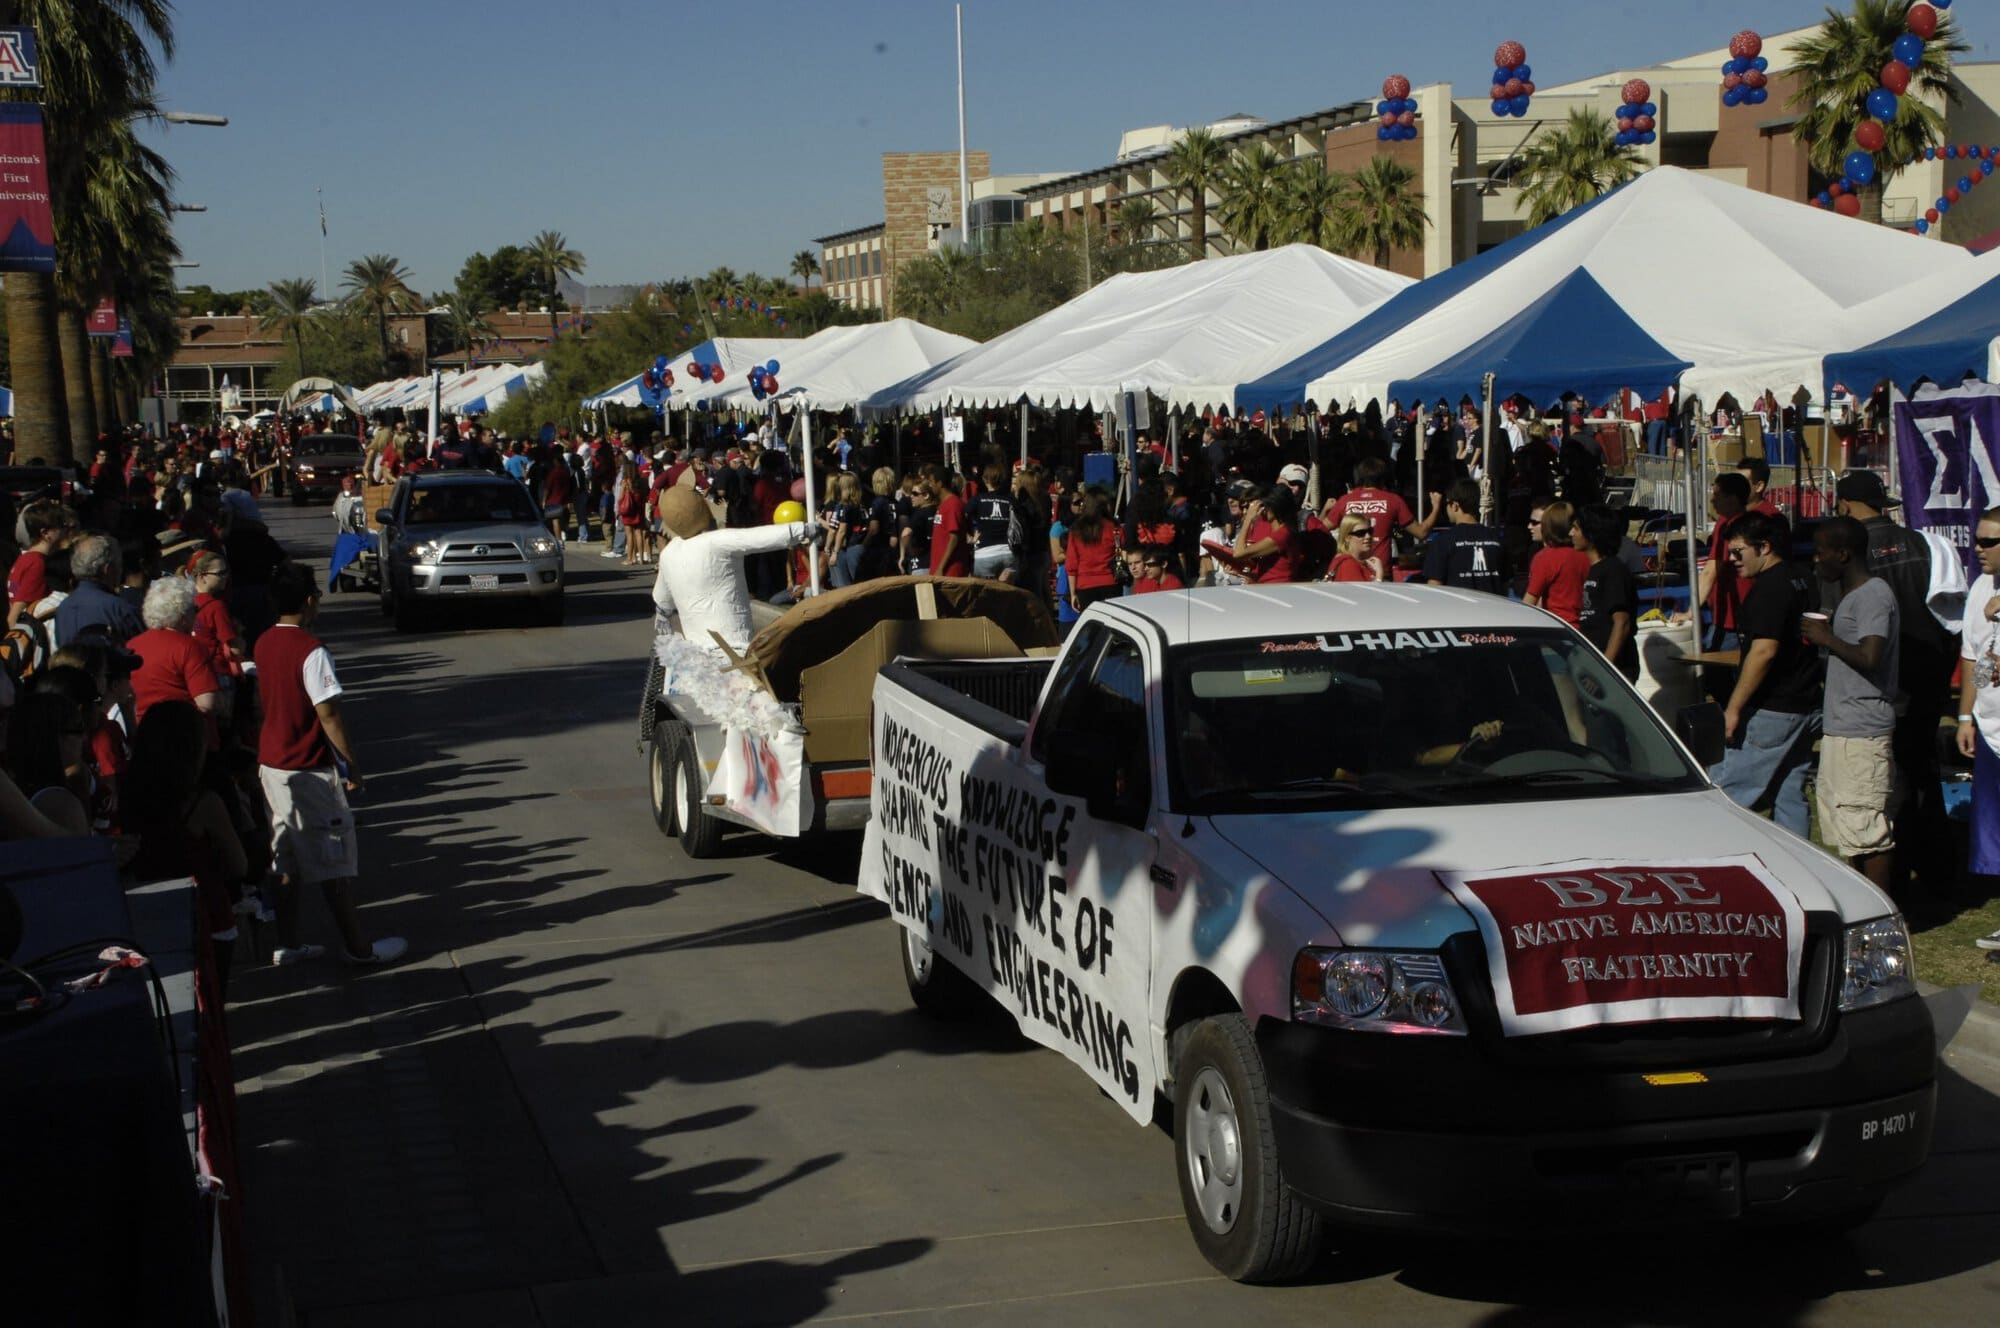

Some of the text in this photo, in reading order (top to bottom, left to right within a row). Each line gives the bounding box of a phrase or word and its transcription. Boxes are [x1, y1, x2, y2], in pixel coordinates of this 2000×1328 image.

[0, 154, 41, 164] rizona's
[3, 173, 30, 184] First
[0, 190, 49, 204] niversity.
[1315, 630, 1472, 652] U-HAUL
[1461, 633, 1517, 646] Pickup
[882, 712, 1076, 867] INDIGENOUS KNOWLEDGE
[880, 776, 1114, 977] SHAPING THE FUTURE OF
[1511, 911, 1782, 949] NATIVE AMERICAN
[1561, 952, 1753, 983] FRATERNITY
[942, 888, 973, 958] AND
[983, 913, 1139, 1104] ENGNEERING
[1862, 1111, 1916, 1140] BP 1470 Y
